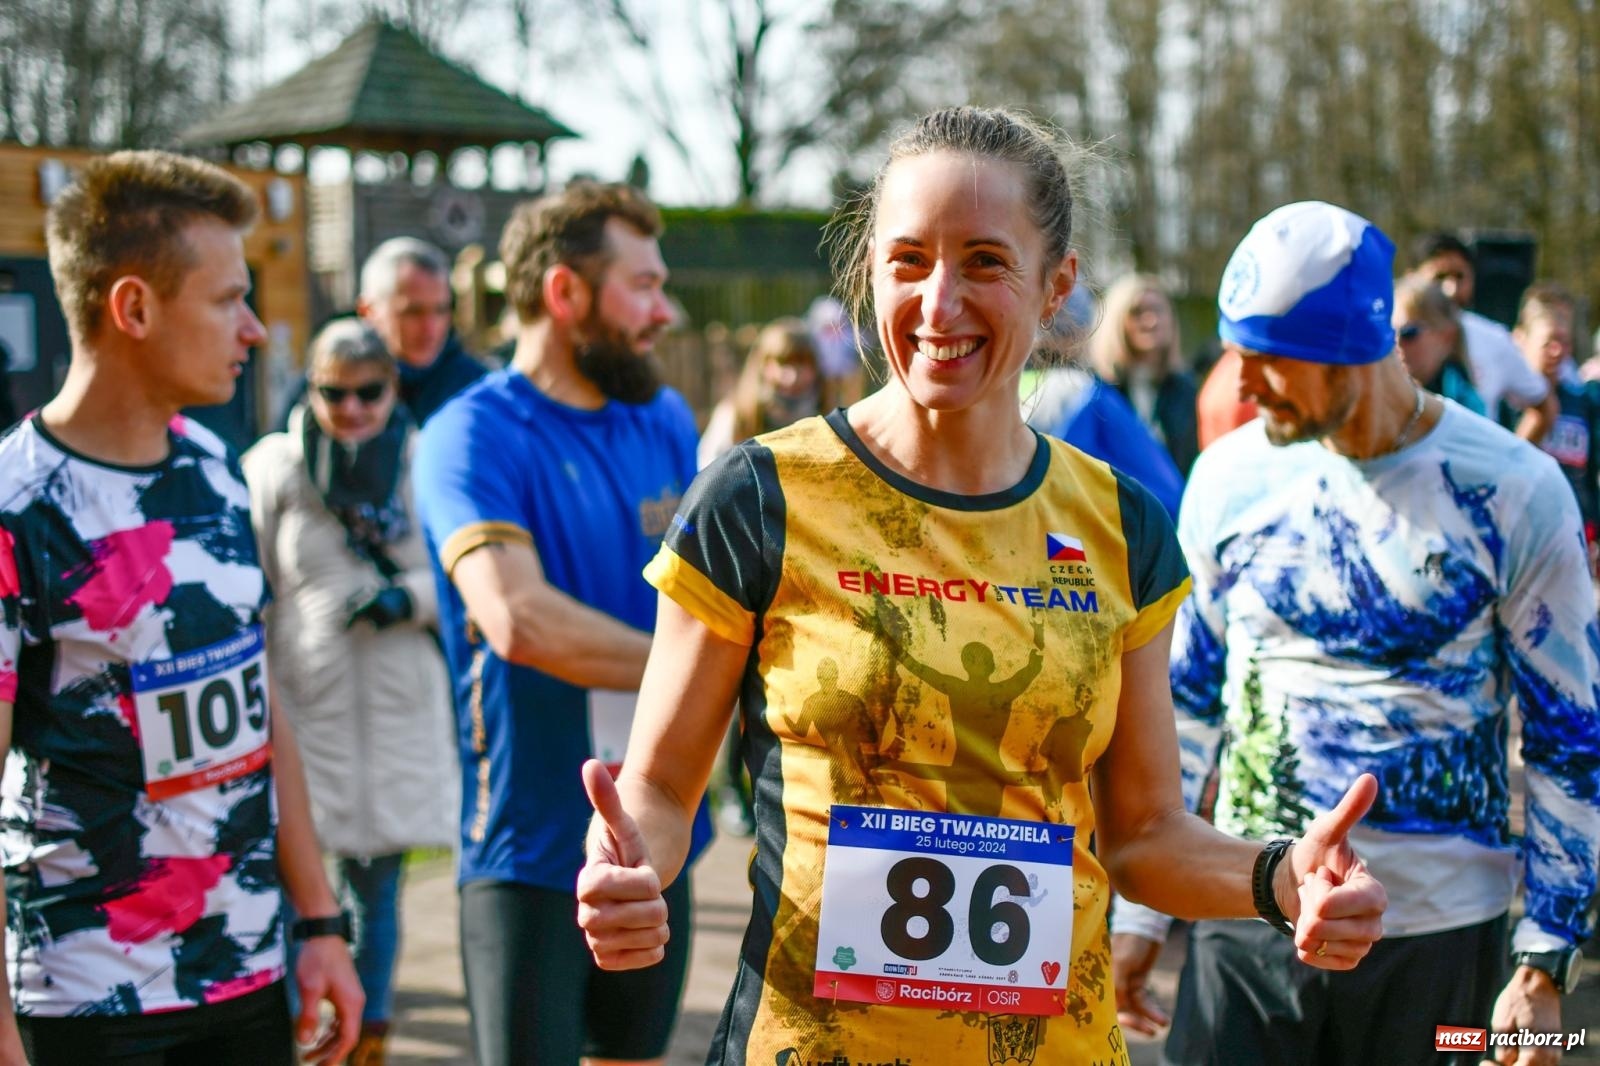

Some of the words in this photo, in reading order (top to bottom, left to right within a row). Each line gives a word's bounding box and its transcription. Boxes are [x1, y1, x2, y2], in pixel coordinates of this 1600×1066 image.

[1049, 565, 1092, 575] CZECH
[1052, 576, 1096, 587] REPUBLIC
[838, 570, 989, 603] ENERGY
[998, 585, 1099, 613] TEAM
[156, 661, 267, 763] 105
[860, 812, 886, 830] XII
[890, 813, 936, 833] BIEG
[939, 818, 1050, 844] TWARDZIELA
[916, 835, 931, 847] 25
[935, 835, 976, 854] lutego
[978, 840, 1006, 854] 2024
[880, 856, 1031, 966] 86
[899, 984, 973, 1003] Racibórz
[987, 990, 1021, 1006] OSiR
